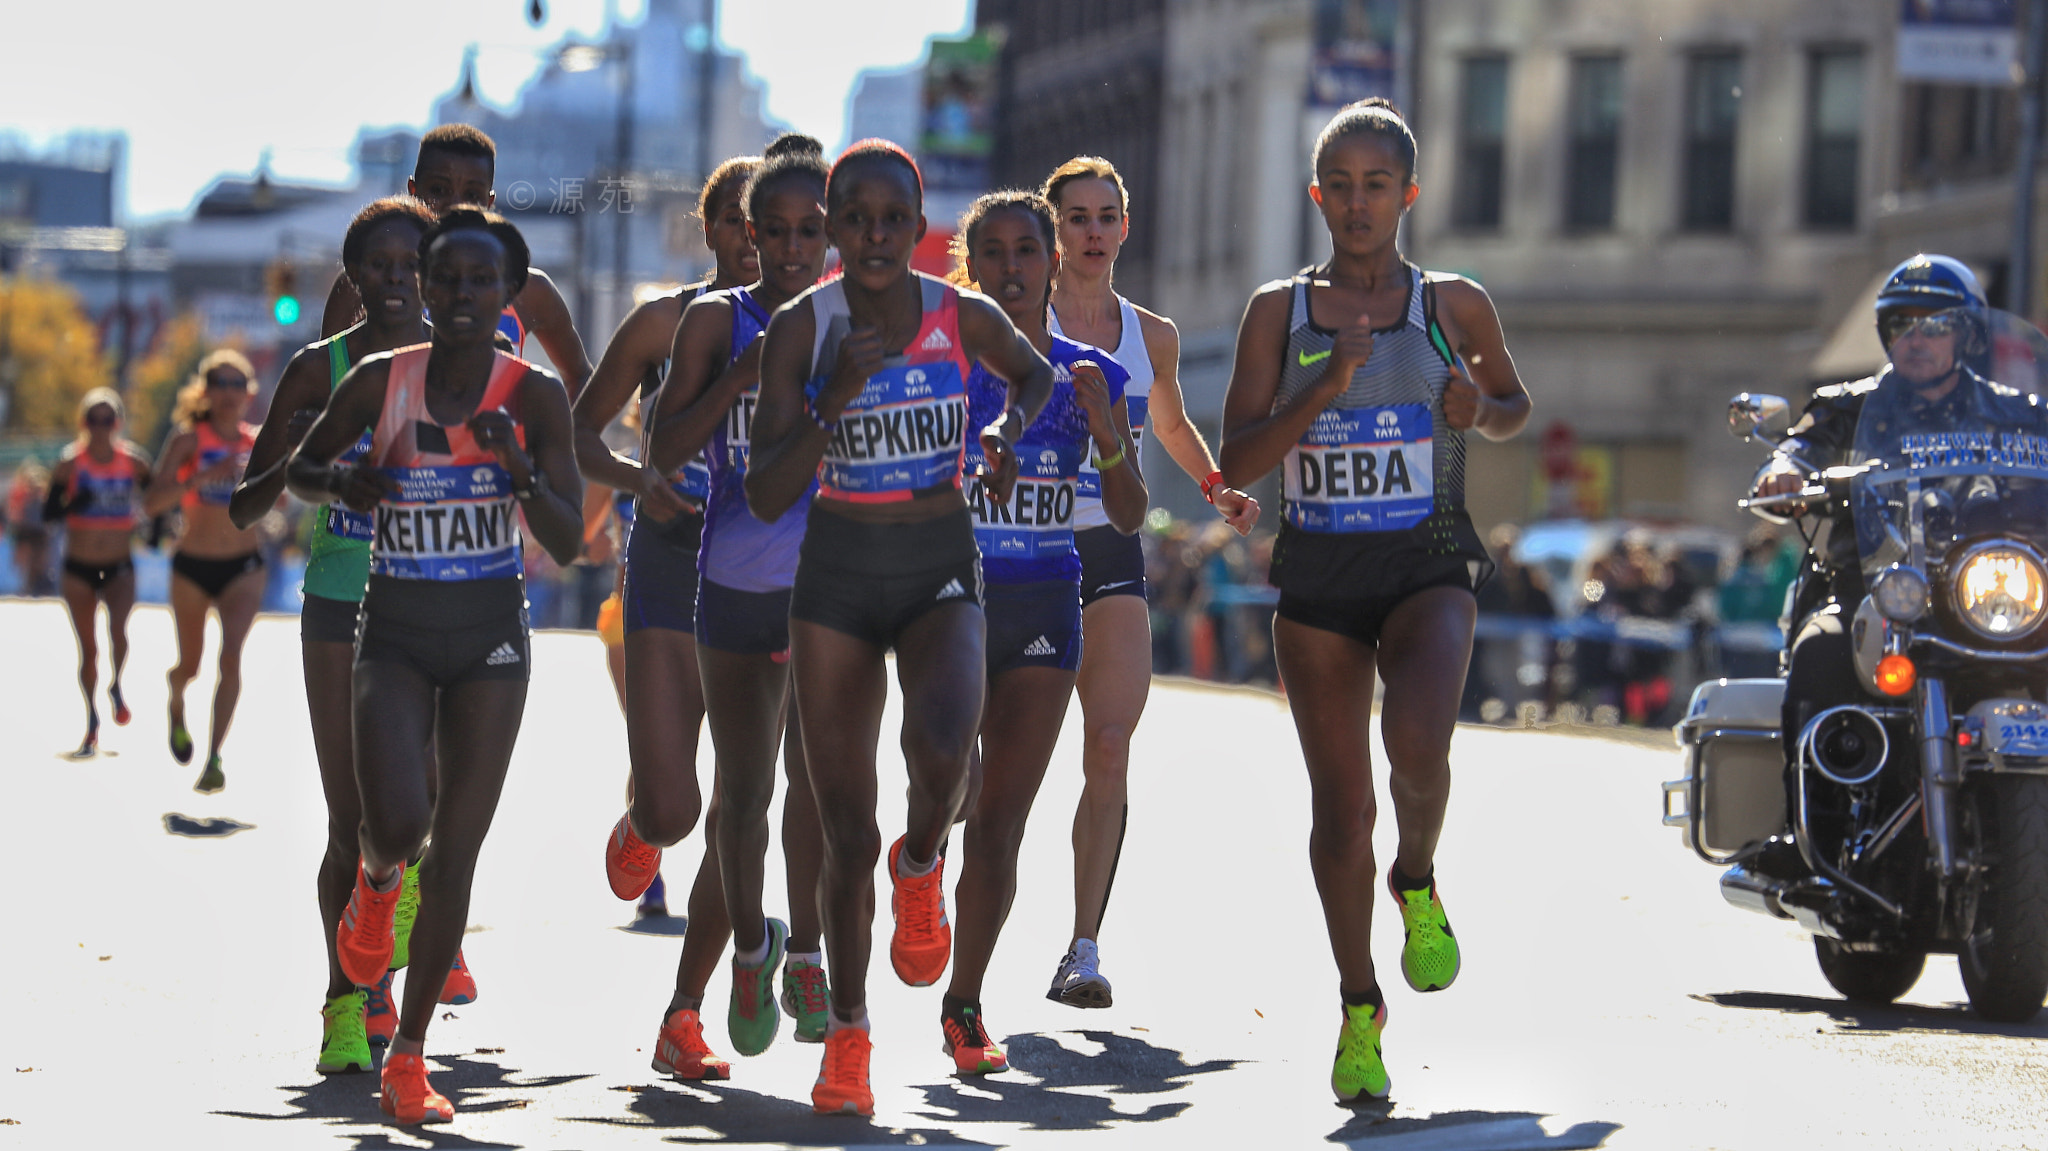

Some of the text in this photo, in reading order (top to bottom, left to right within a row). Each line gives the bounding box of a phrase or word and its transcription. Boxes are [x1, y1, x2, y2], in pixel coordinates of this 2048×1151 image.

[904, 384, 932, 398] TATA
[825, 402, 963, 459] HEPKIRUI
[1374, 426, 1402, 440] TATA
[409, 468, 437, 479] TATA
[1036, 464, 1060, 475] TATA
[1299, 449, 1412, 497] DEBA
[470, 484, 498, 496] TATA
[376, 500, 516, 553] KEITANY
[1024, 647, 1057, 656] adidas
